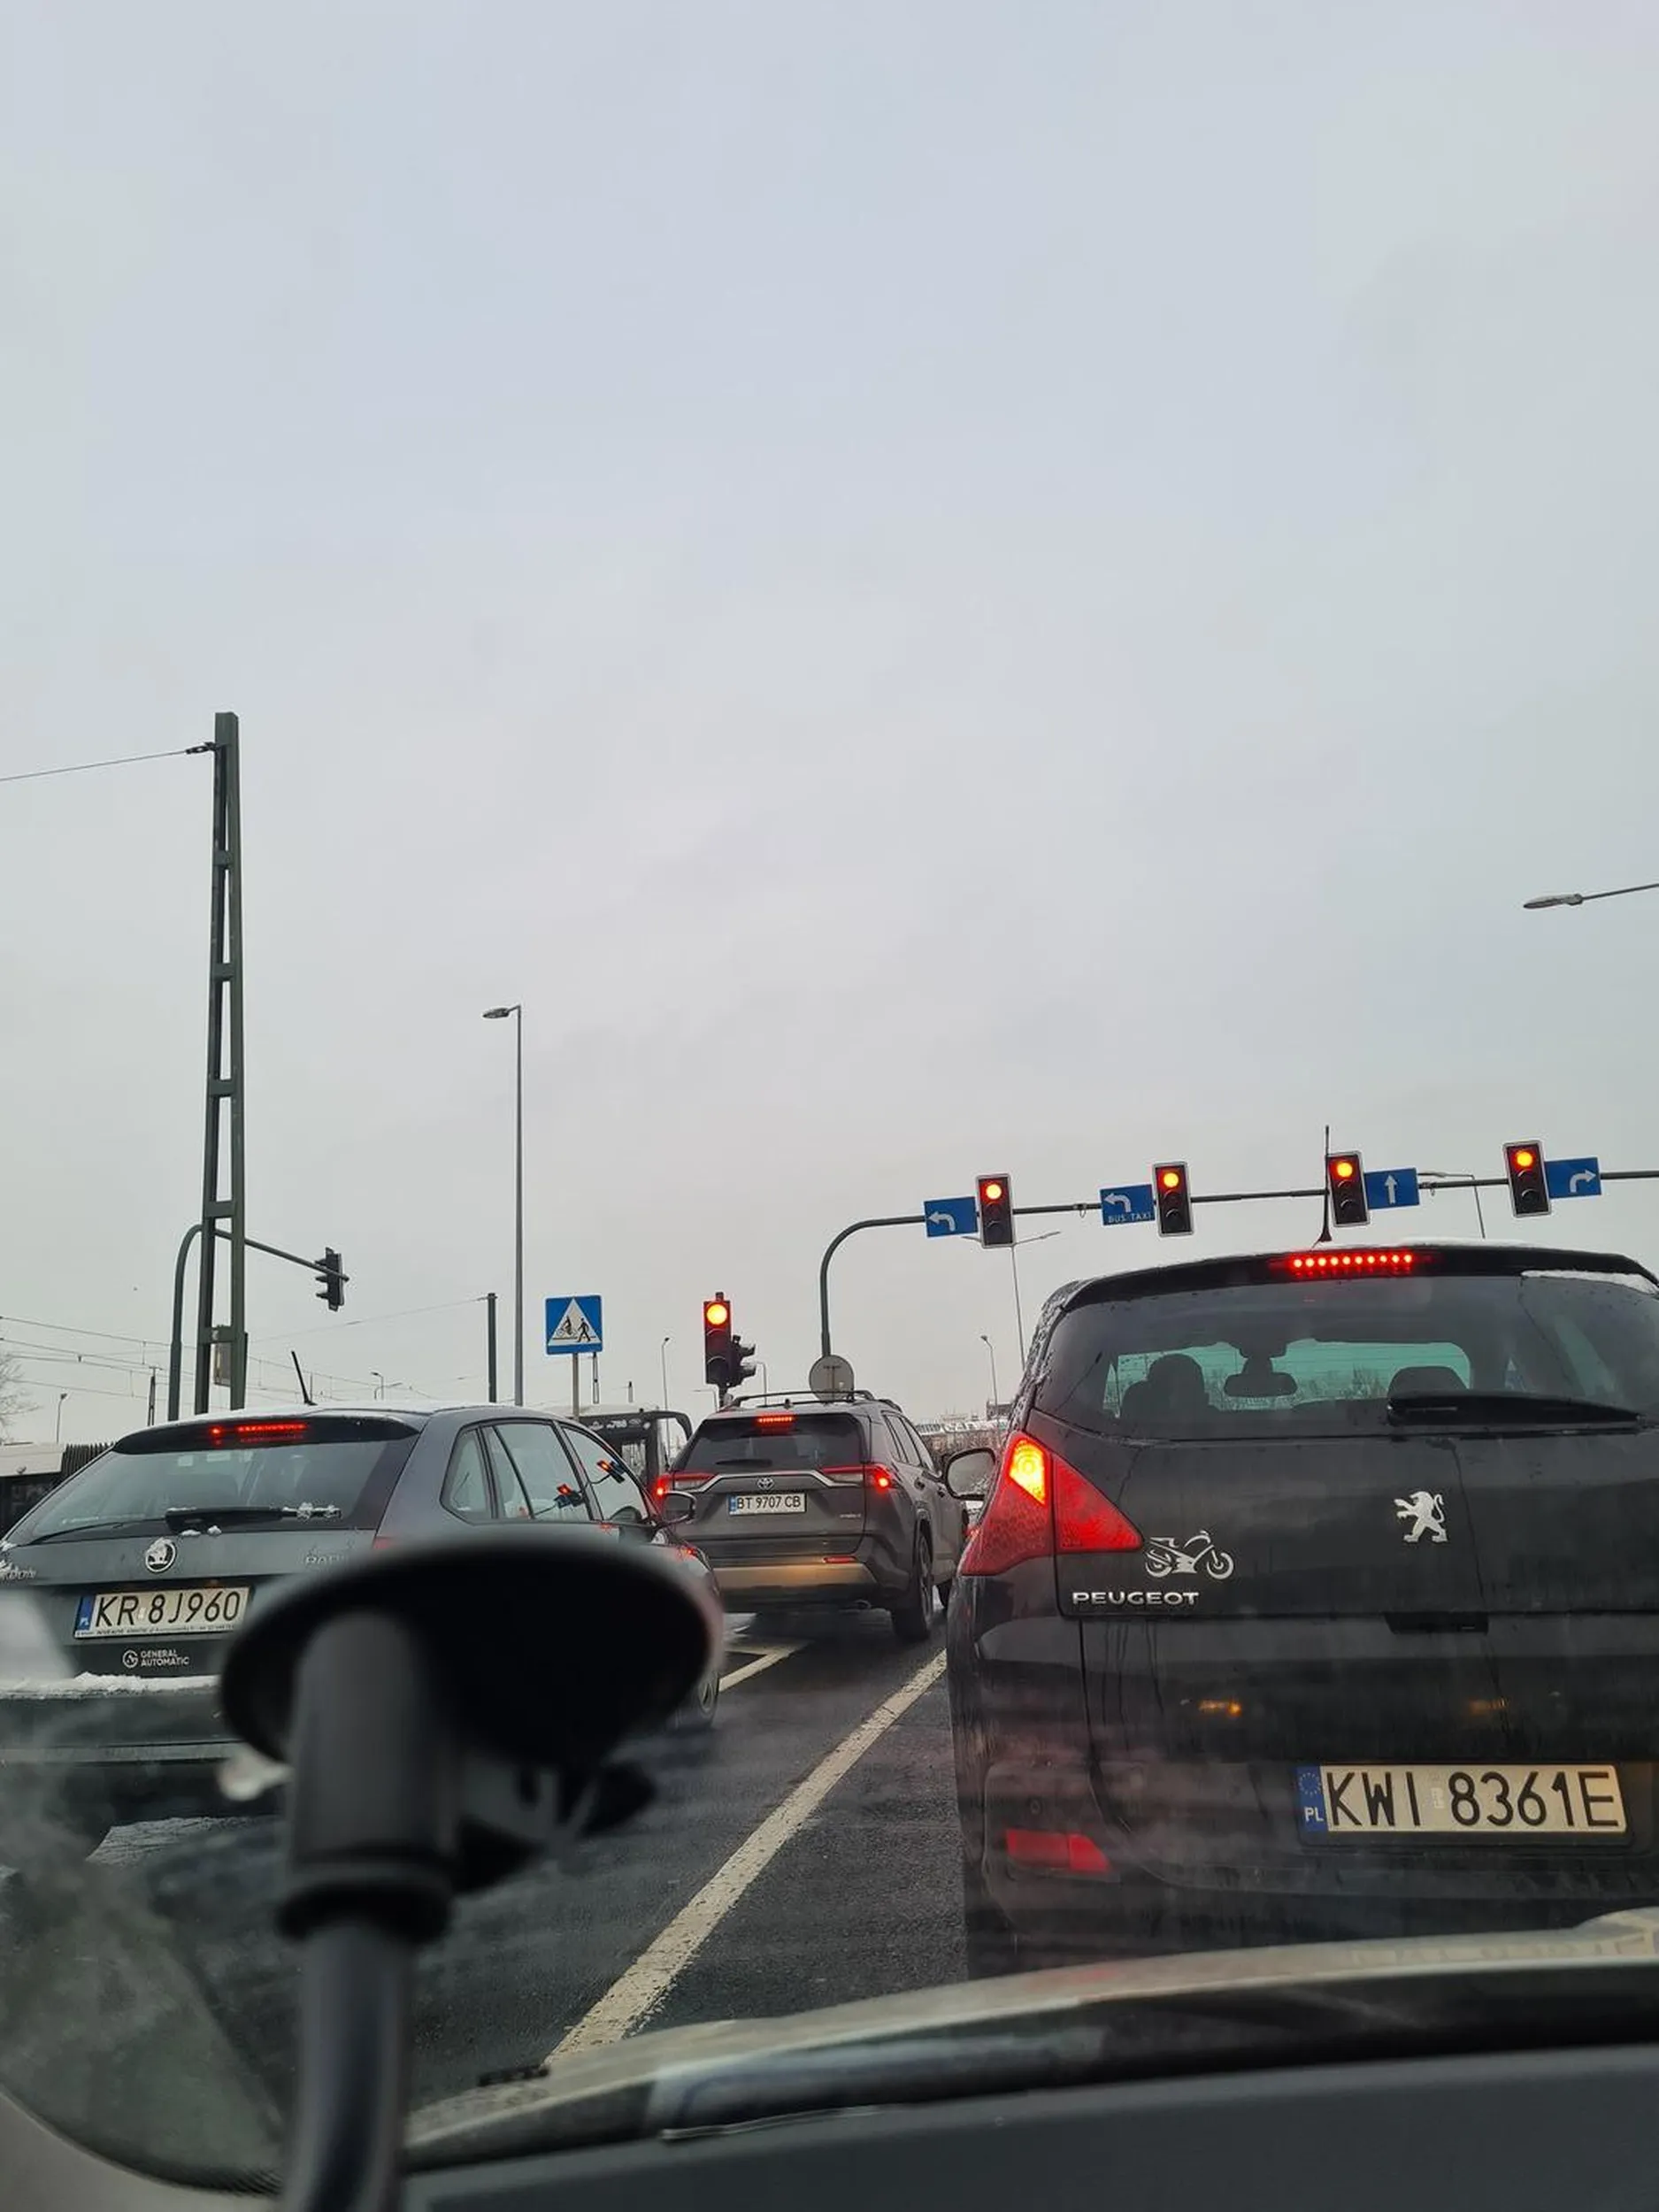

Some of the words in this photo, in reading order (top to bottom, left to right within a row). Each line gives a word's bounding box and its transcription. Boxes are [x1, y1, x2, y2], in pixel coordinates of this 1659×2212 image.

[1108, 1214, 1126, 1223] BUS
[736, 1497, 752, 1509] BT
[756, 1495, 781, 1508] 9707
[784, 1495, 801, 1508] CB
[1072, 1592, 1199, 1605] PEUGEOT
[95, 1595, 139, 1627] KR
[148, 1591, 241, 1624] 8J960
[141, 1649, 178, 1658] GENERAL
[141, 1656, 190, 1667] AUTOMATIC
[1326, 1771, 1421, 1826] KWI
[1448, 1771, 1618, 1827] 8361E
[1304, 1806, 1325, 1822] PL
